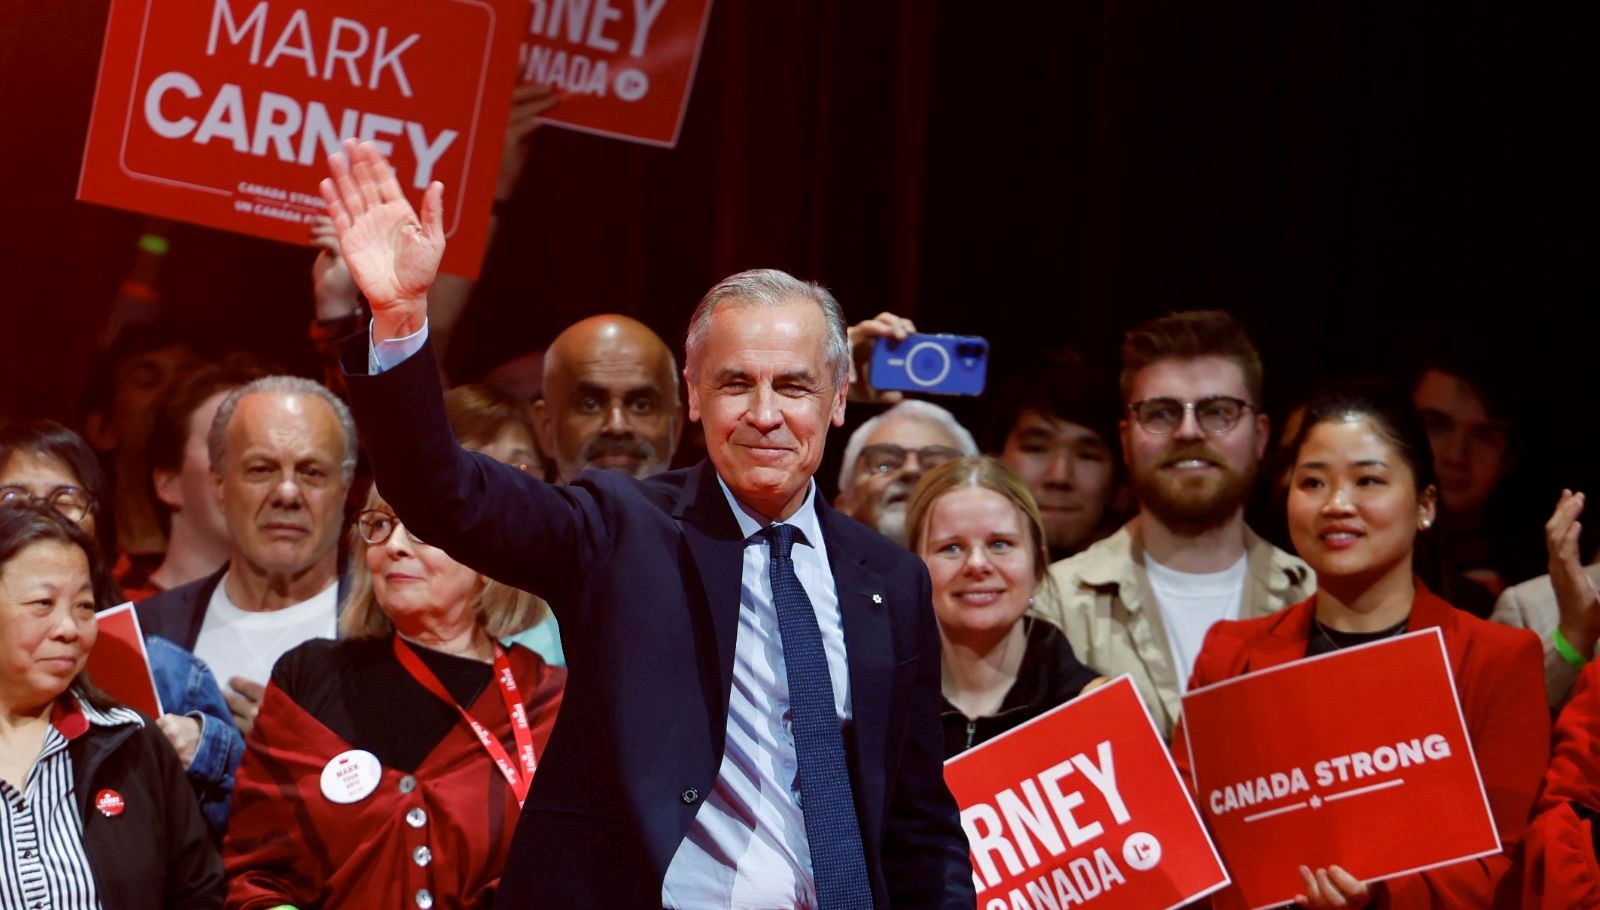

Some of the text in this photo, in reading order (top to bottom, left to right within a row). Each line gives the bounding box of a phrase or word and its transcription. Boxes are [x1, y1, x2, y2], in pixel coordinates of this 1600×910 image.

[206, 0, 421, 97] MARK
[527, 0, 666, 57] NEY
[519, 42, 609, 97] NADA
[144, 71, 459, 189] CARNEY
[238, 181, 287, 200] CANADA
[254, 204, 302, 222] CANADA
[336, 763, 359, 778] MARK
[1209, 734, 1451, 815] CANADA STRONG
[959, 740, 1132, 894] RNEY
